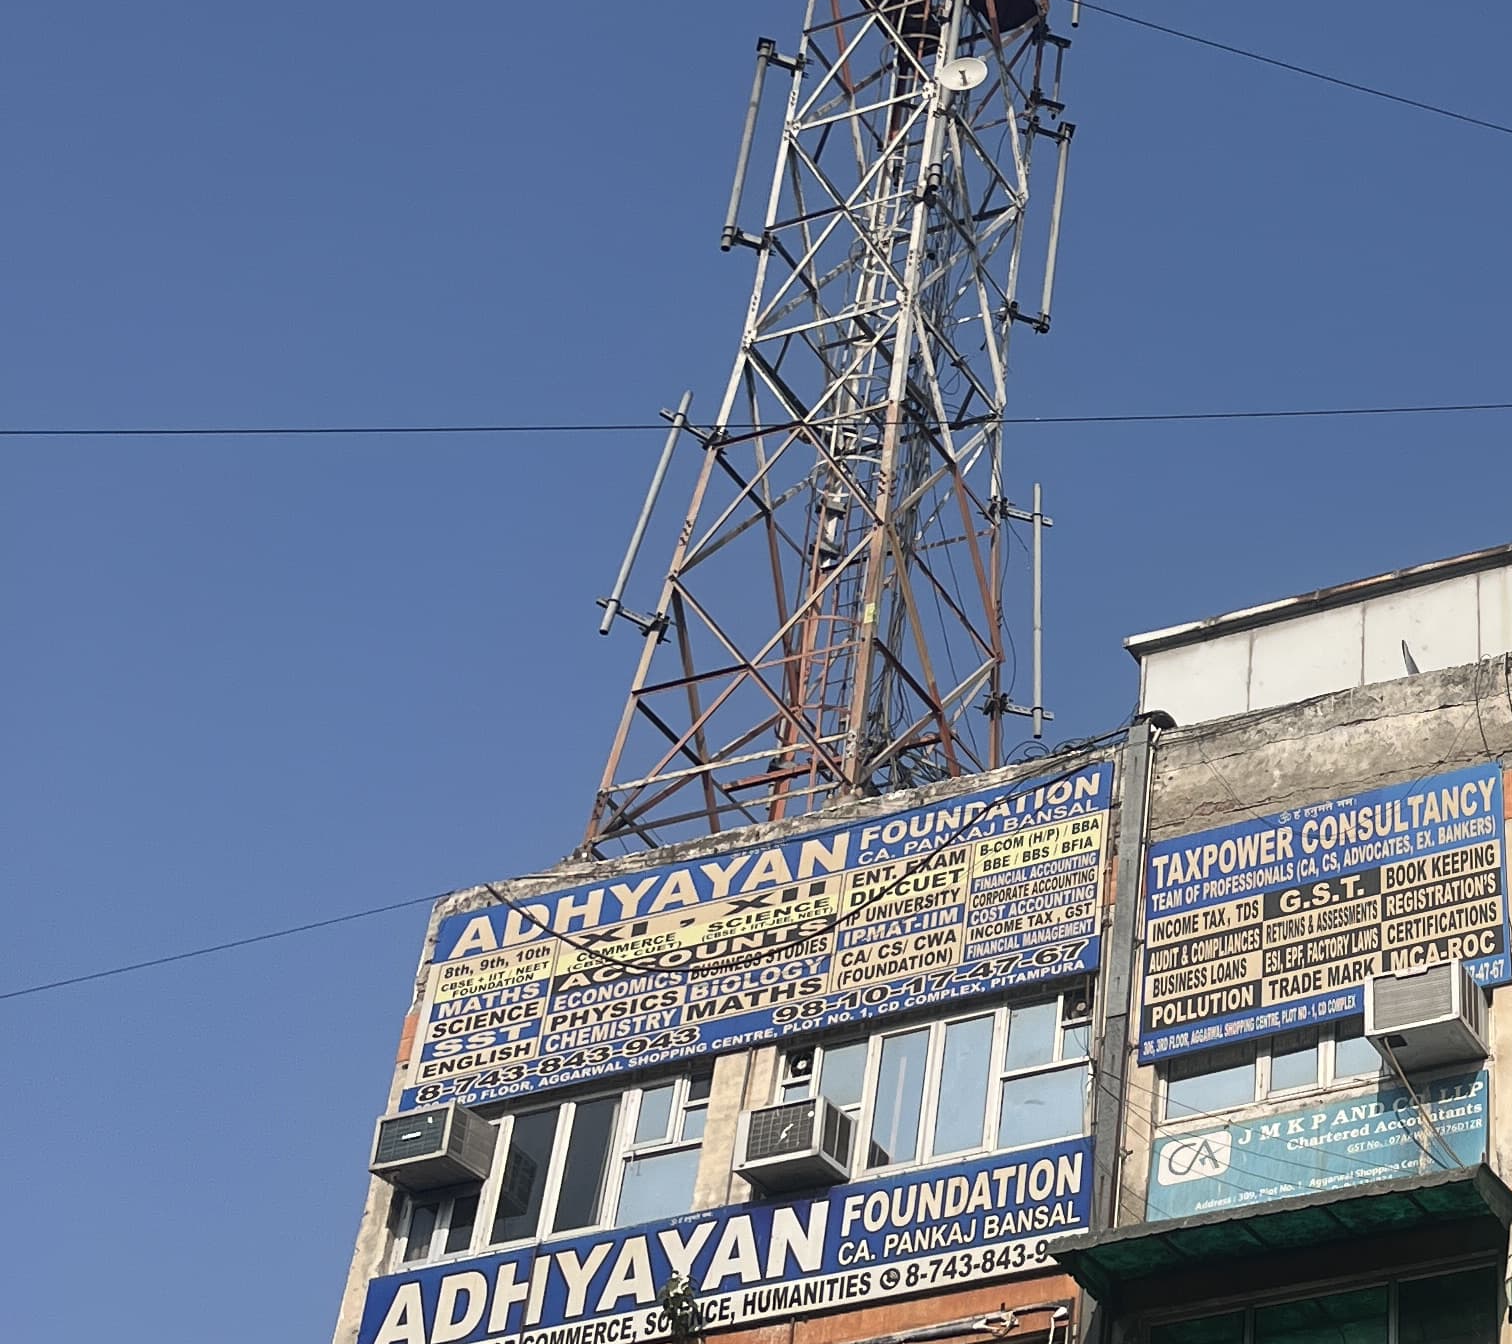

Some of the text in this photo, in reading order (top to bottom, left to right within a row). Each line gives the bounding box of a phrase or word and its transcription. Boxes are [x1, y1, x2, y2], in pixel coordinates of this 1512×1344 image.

[860, 773, 1100, 849] FOUNDATION
[1003, 800, 1099, 830] BANSAL
[1152, 777, 1496, 890] TAXPOWER CONSULTANCY
[1203, 863, 1294, 901] PROFESSIONALS
[1386, 844, 1495, 889] BOOK KEEPING
[448, 831, 850, 959] ADHYAYAN
[866, 888, 960, 921] UNIVERSITY
[1008, 885, 1094, 918] ACCOUNTING
[1280, 872, 1496, 916] G.S.T. REGISTRATION'S
[843, 908, 959, 947] IPMAT-IIM
[1387, 900, 1497, 946] CERTIFICATIONS
[444, 946, 550, 980] 8th, 9th, 10th
[772, 940, 1089, 1025] 98-10-17-47-67
[837, 947, 953, 990] (FOUNDATION)
[1268, 957, 1375, 1001] TRADE MARK
[438, 982, 540, 1019] MATHS
[551, 978, 822, 1032] PHYSICS MATHS
[554, 972, 682, 1012] ECONOMICS
[1152, 985, 1254, 1028] POLLUTION
[432, 1001, 538, 1039] SCIENCE
[432, 1022, 532, 1057] SST
[538, 960, 1085, 1088] AGGARWAL SHOPPING PITAMPURA
[545, 1008, 678, 1053] CHEMISTRY
[416, 1027, 699, 1104] 8-743-843-943
[422, 1042, 531, 1079] ENGLISH
[1286, 1122, 1370, 1152] Chartered
[841, 1152, 1083, 1237] FOUNDATION
[838, 1200, 1080, 1267] CA. PANKAJ BANSAL
[743, 1272, 872, 1315] HUMANITIES
